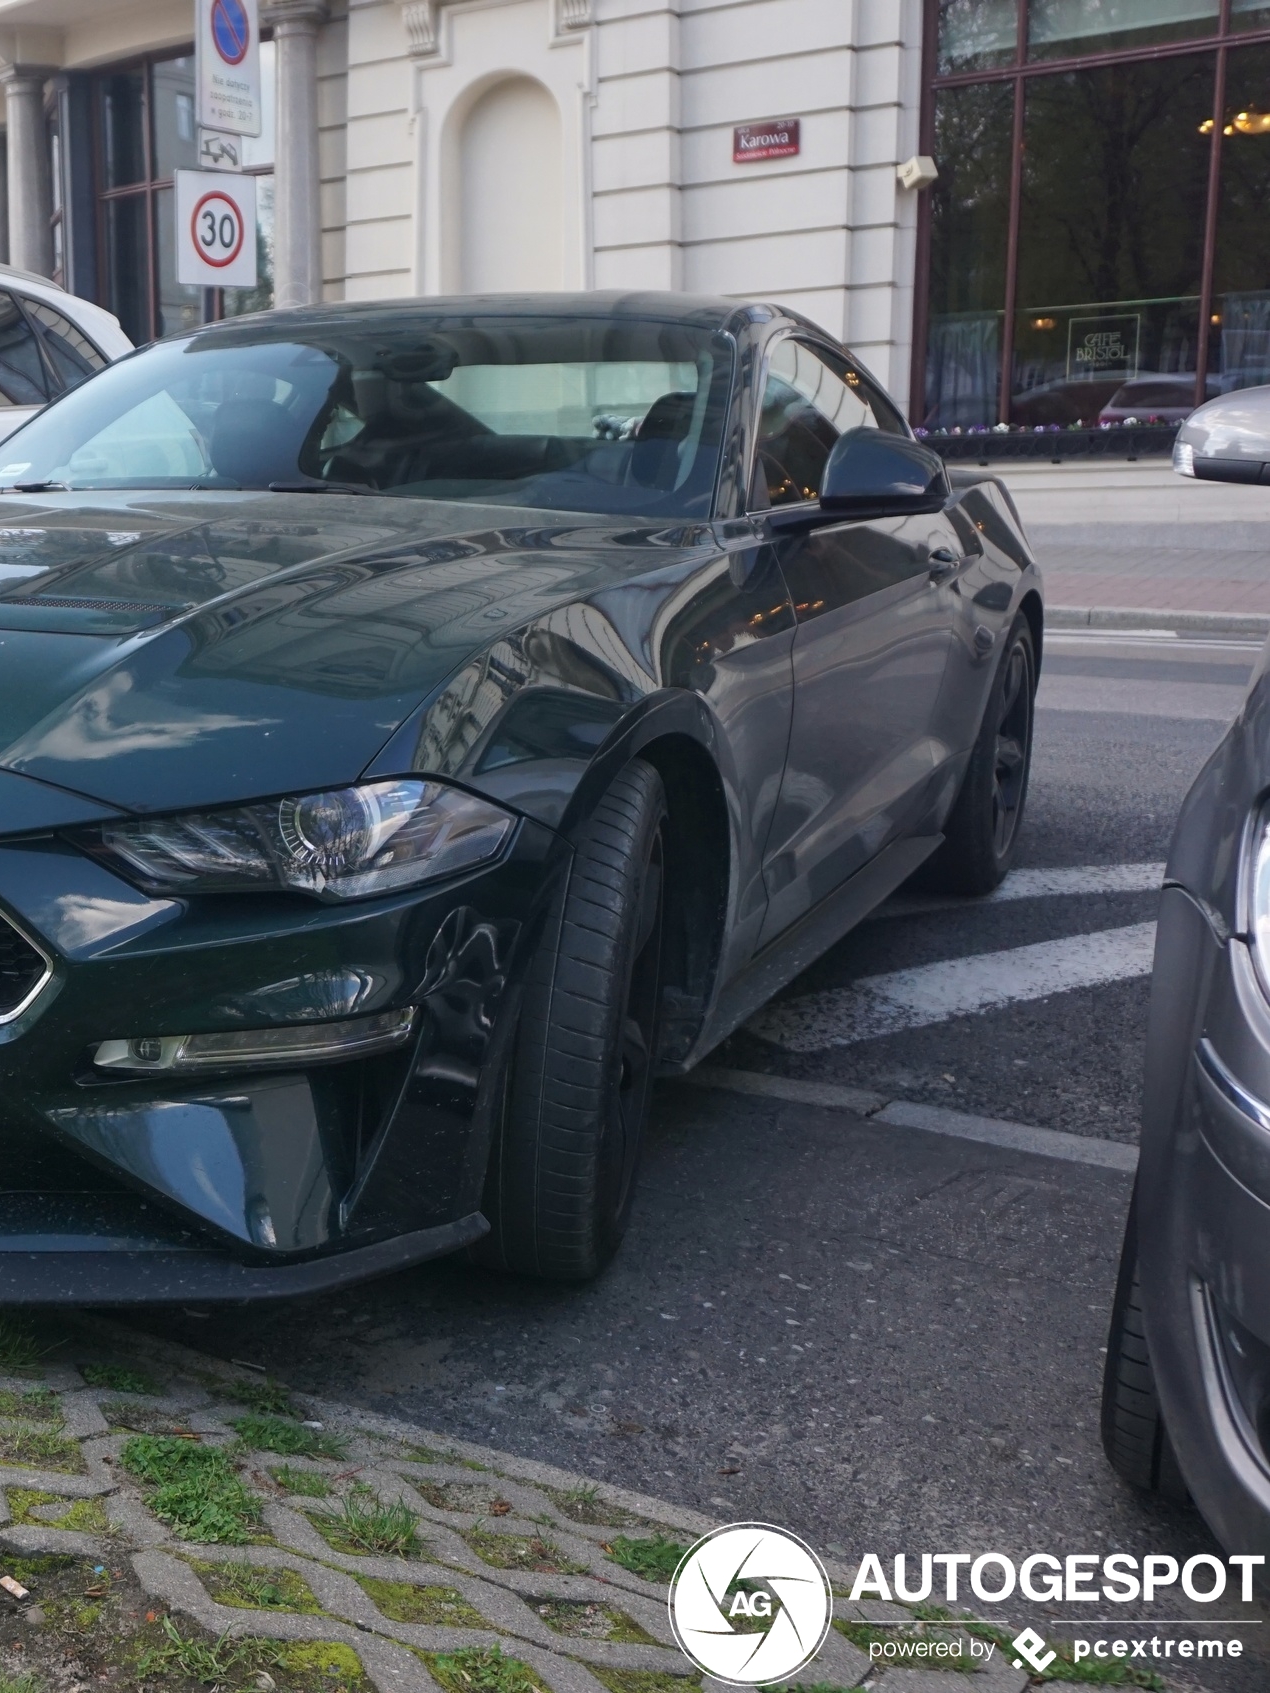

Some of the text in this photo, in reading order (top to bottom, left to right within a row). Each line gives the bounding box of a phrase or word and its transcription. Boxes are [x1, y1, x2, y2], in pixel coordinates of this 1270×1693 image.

[741, 132, 789, 149] Karowa
[201, 210, 235, 248] 30
[1076, 345, 1131, 361] BRISTOL
